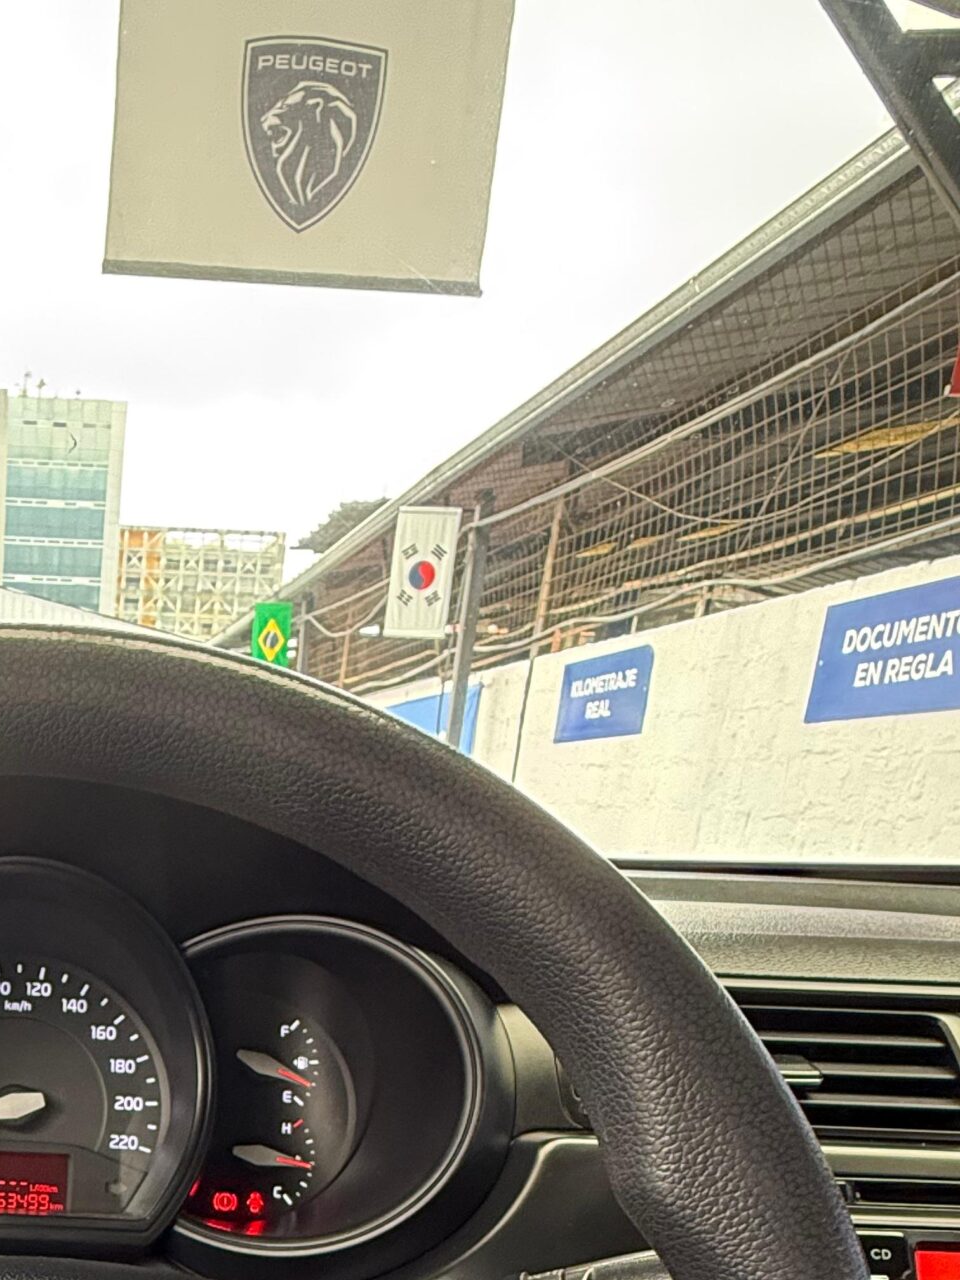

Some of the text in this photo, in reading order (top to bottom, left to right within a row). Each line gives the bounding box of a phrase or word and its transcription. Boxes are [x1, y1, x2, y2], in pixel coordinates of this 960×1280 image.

[257, 54, 373, 79] PEUGEOT
[852, 649, 954, 688] EN REGLA
[570, 667, 639, 699] KILOMETRAJE
[584, 699, 612, 720] REAL
[25, 981, 52, 997] 120
[4, 999, 32, 1012] km/h
[62, 998, 88, 1014] 140
[90, 1025, 117, 1041] 160
[280, 1025, 290, 1038] F
[109, 1058, 136, 1074] 180
[113, 1095, 144, 1111] 200
[282, 1090, 292, 1103] E
[281, 1122, 292, 1135] H
[109, 1134, 139, 1150] 220
[273, 1185, 282, 1199] C
[870, 1248, 892, 1261] CD
